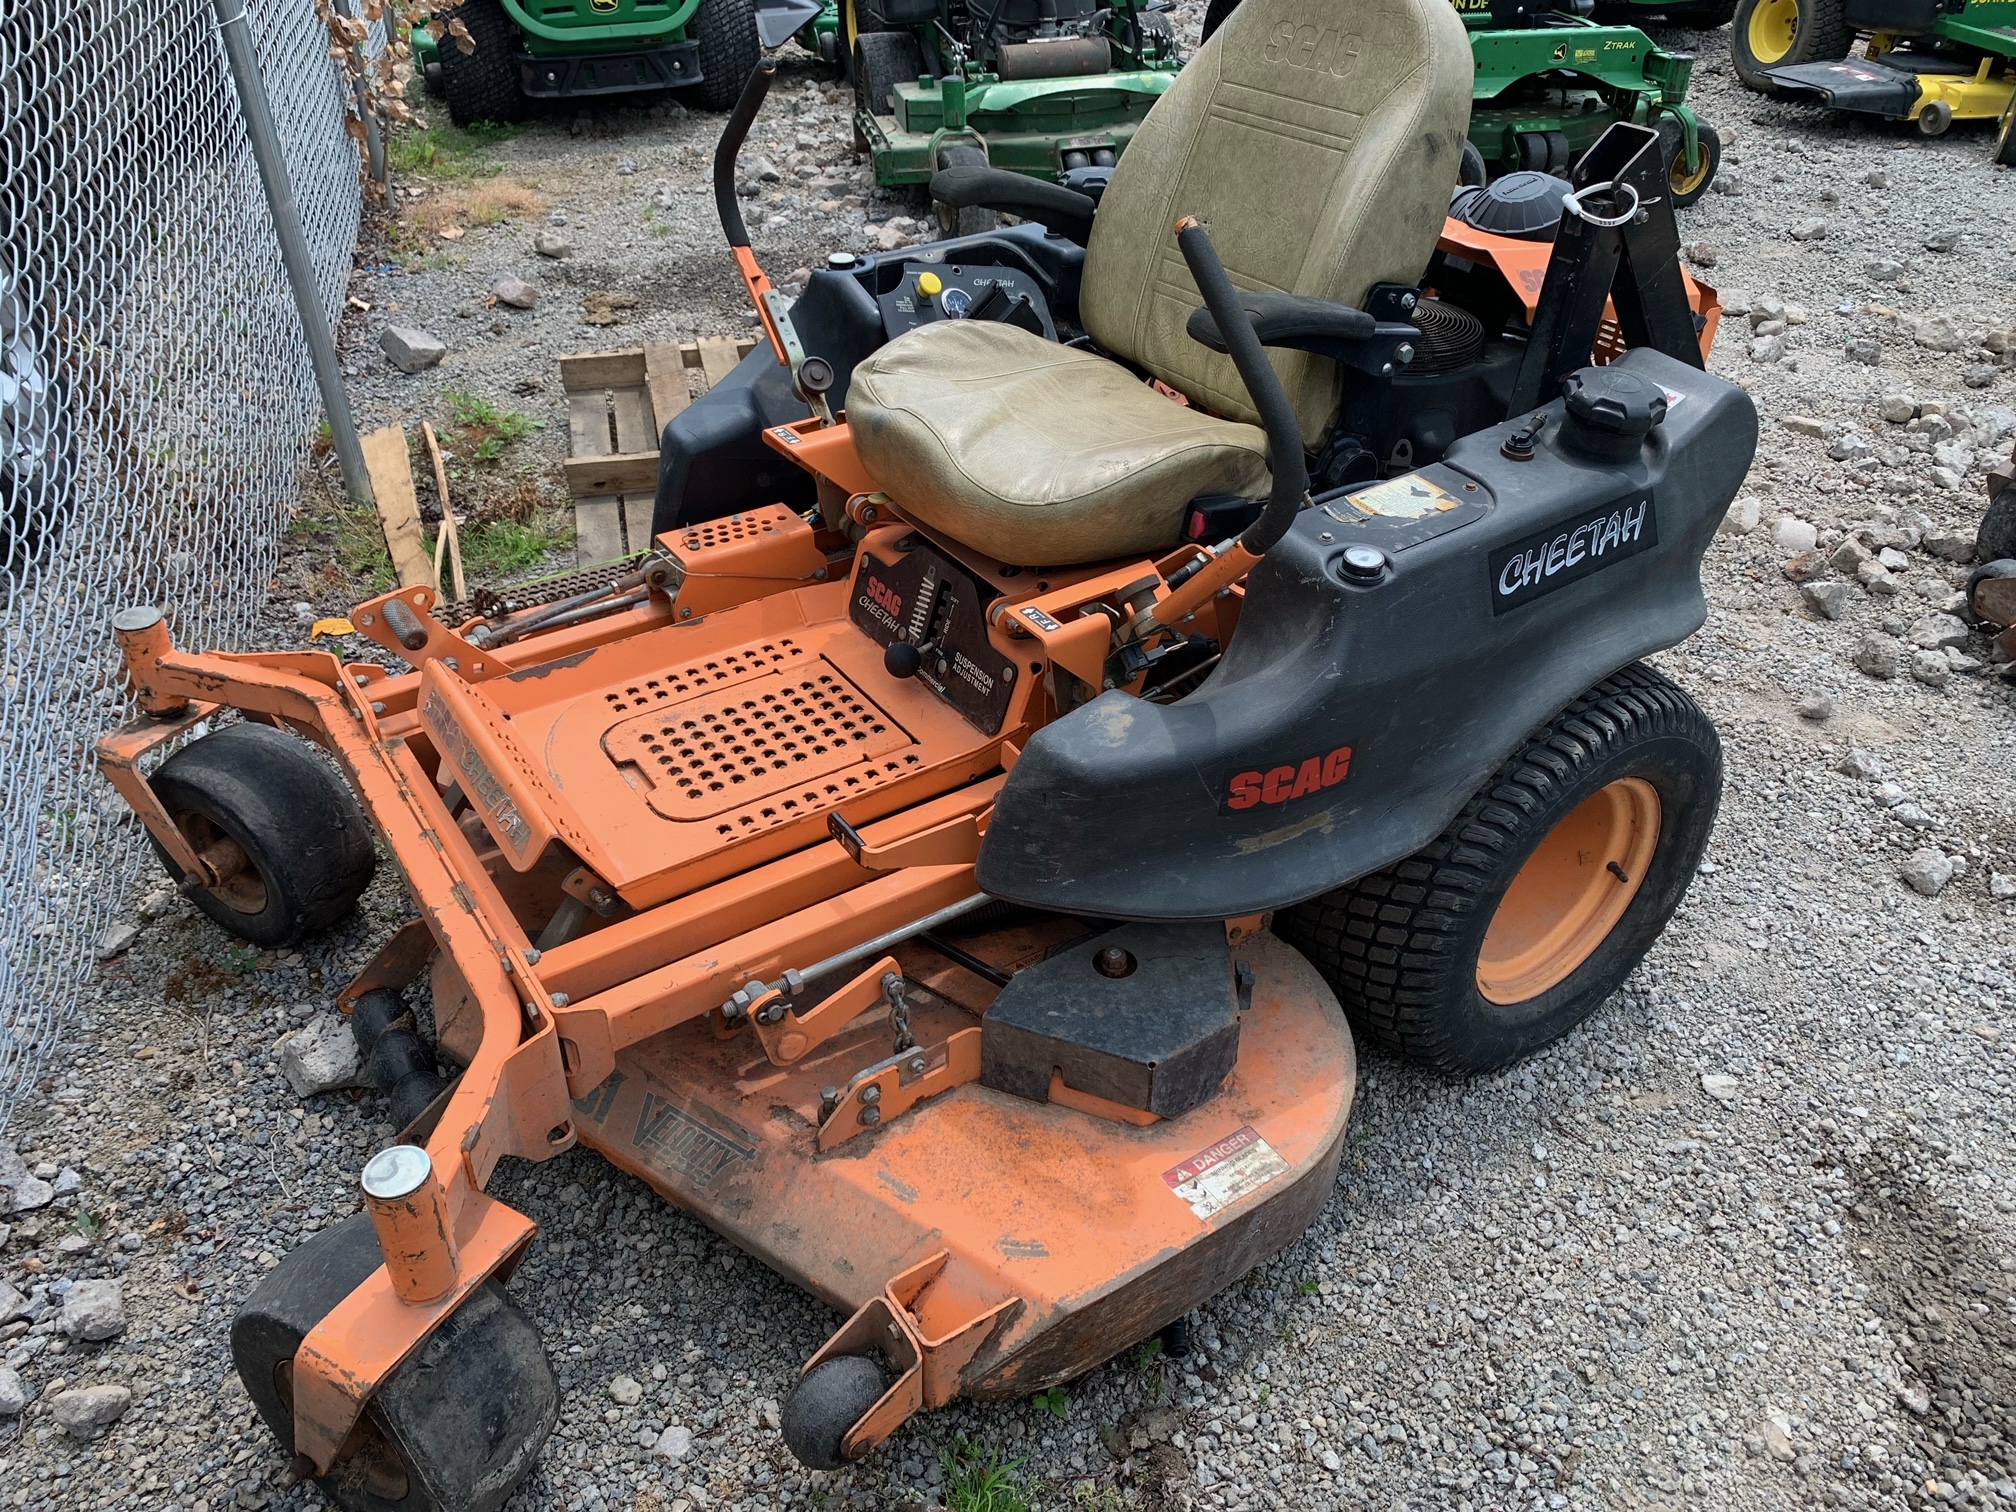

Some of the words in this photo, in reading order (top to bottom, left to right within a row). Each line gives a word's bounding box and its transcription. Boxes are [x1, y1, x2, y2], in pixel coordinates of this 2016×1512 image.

[1263, 19, 1364, 78] SCAG
[1603, 40, 1636, 51] ZTRAK
[973, 278, 1015, 288] CHETAH
[1520, 269, 1545, 293] SC
[1498, 500, 1646, 596] CHEETAH
[858, 595, 900, 633] CHEETAH
[866, 575, 902, 617] SCAG
[952, 662, 991, 697] ADJUSTMENT
[954, 651, 994, 689] SUSPENSION
[459, 747, 532, 847] CHEETAH
[1227, 746, 1352, 810] SCAG
[1192, 1133, 1251, 1172] DANGER
